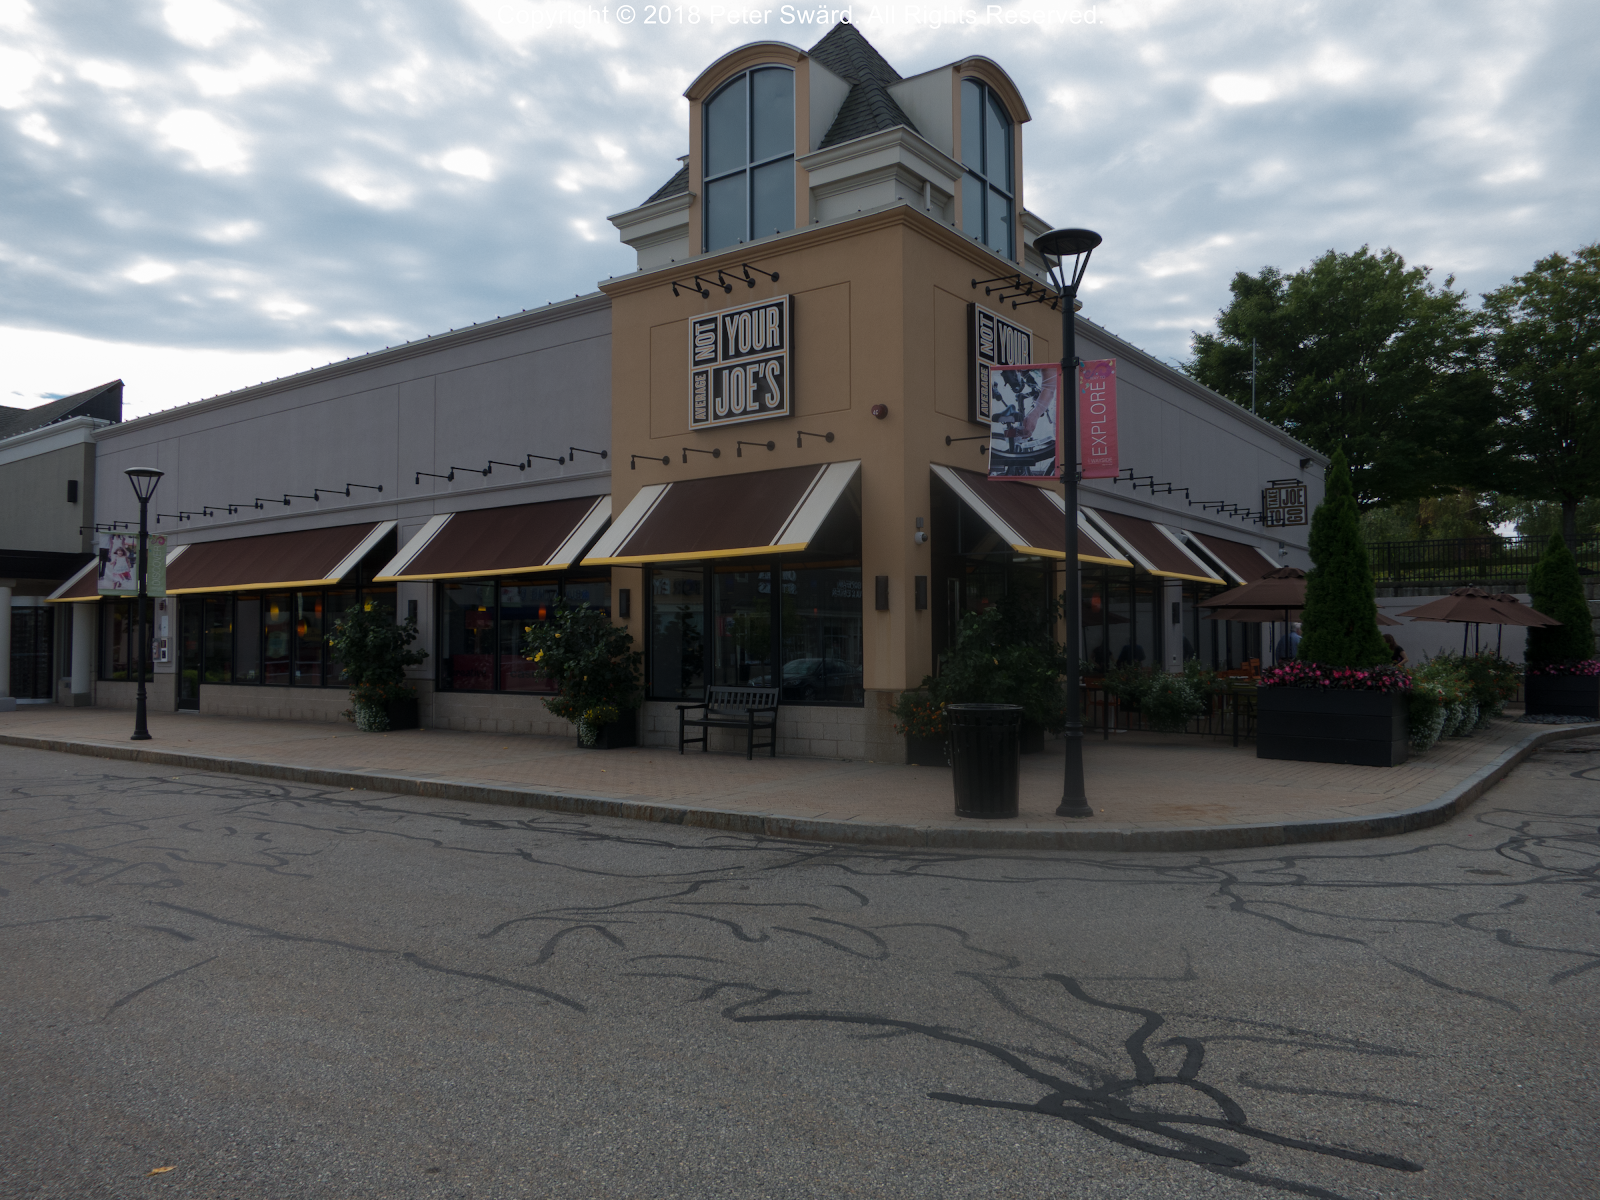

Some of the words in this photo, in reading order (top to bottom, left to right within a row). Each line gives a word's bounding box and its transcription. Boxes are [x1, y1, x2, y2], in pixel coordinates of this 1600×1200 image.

[695, 322, 715, 361] NOT
[725, 306, 780, 356] YOUR
[979, 313, 994, 357] NOT
[998, 322, 1029, 365] YOUR
[695, 373, 707, 420] AVERAGE
[715, 360, 781, 417] JOE'S
[980, 366, 989, 416] AVERAGE
[1090, 381, 1108, 456] EXPLORE
[1268, 491, 1278, 506] TAKE
[1282, 488, 1303, 506] JOE
[1286, 508, 1303, 523] GO
[151, 545, 162, 586] DISCOVER
